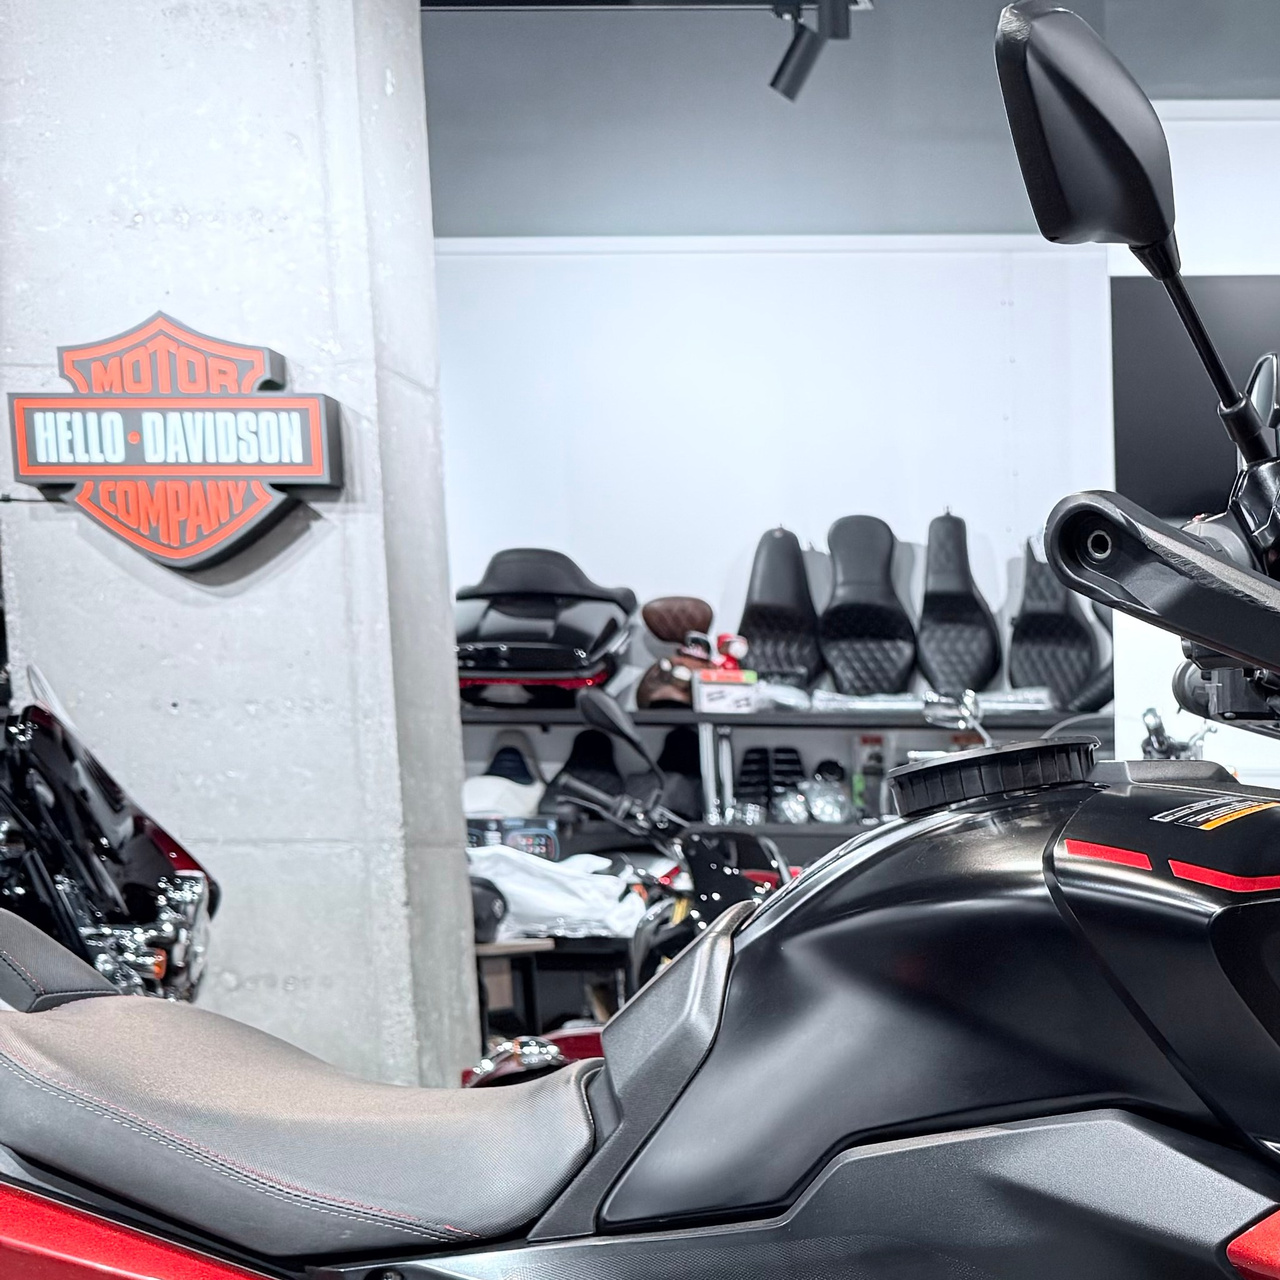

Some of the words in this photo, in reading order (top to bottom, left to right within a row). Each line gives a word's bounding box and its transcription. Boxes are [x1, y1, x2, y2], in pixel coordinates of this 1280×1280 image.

[91, 334, 239, 394] MOTOR
[33, 411, 125, 463] HELLO
[141, 411, 303, 463] DAVIDSON
[99, 480, 247, 546] COMPANY
